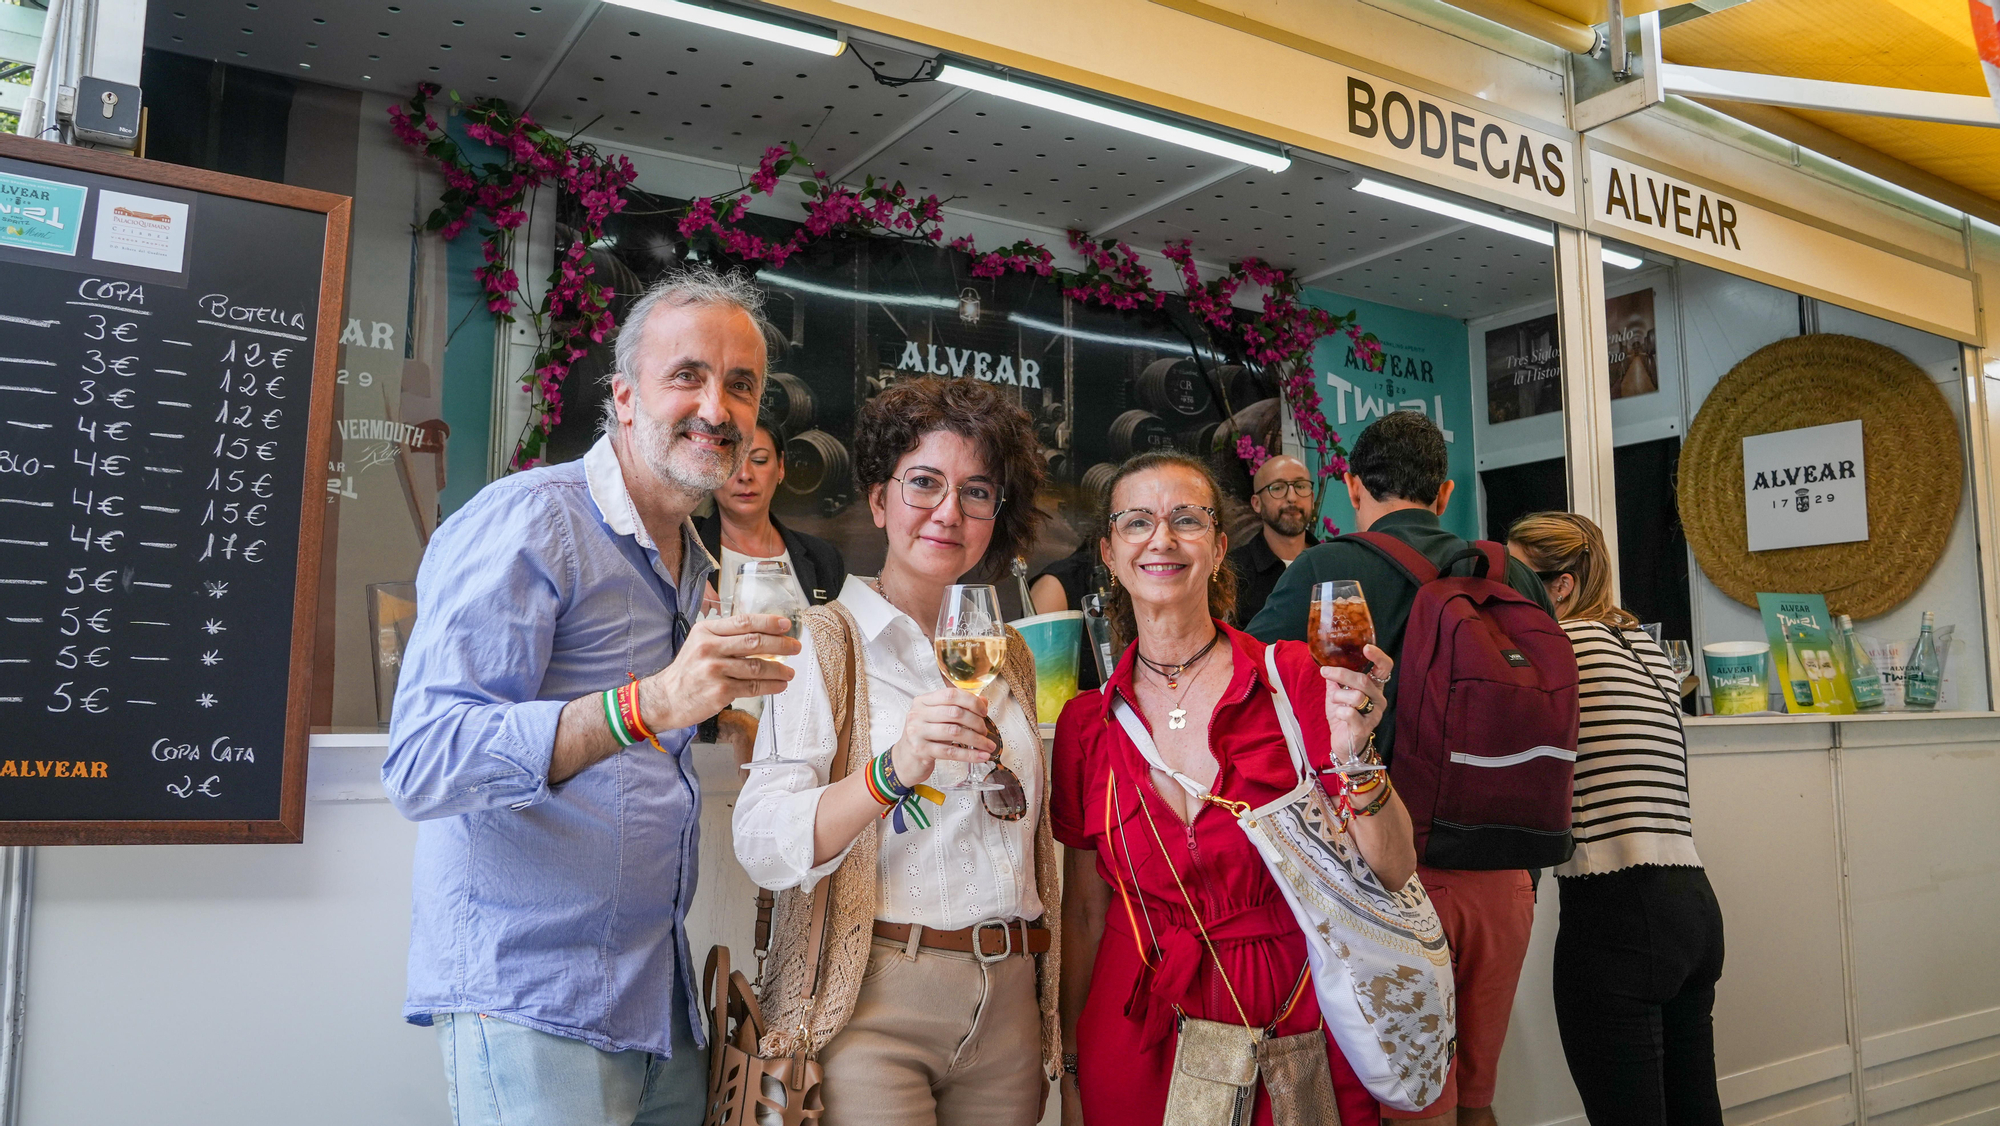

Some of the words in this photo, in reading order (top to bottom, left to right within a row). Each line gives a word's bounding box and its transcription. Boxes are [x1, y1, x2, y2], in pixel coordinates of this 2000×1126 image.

[119, 126, 133, 134] Nice
[1605, 167, 1742, 251] ALVEAR
[78, 278, 145, 305] COPA
[198, 293, 306, 330] BOTELLA
[897, 340, 1041, 390] ALVEAR
[1506, 354, 1529, 370] Tres
[1531, 345, 1560, 365] Siglo
[1513, 373, 1524, 386] la
[337, 419, 425, 449] VERMOUTH
[1752, 460, 1857, 491] ALVEAR
[1780, 603, 1811, 613] ALVEAR
[1716, 665, 1753, 674] ALVEAR
[0, 760, 109, 778] ALVEAR
